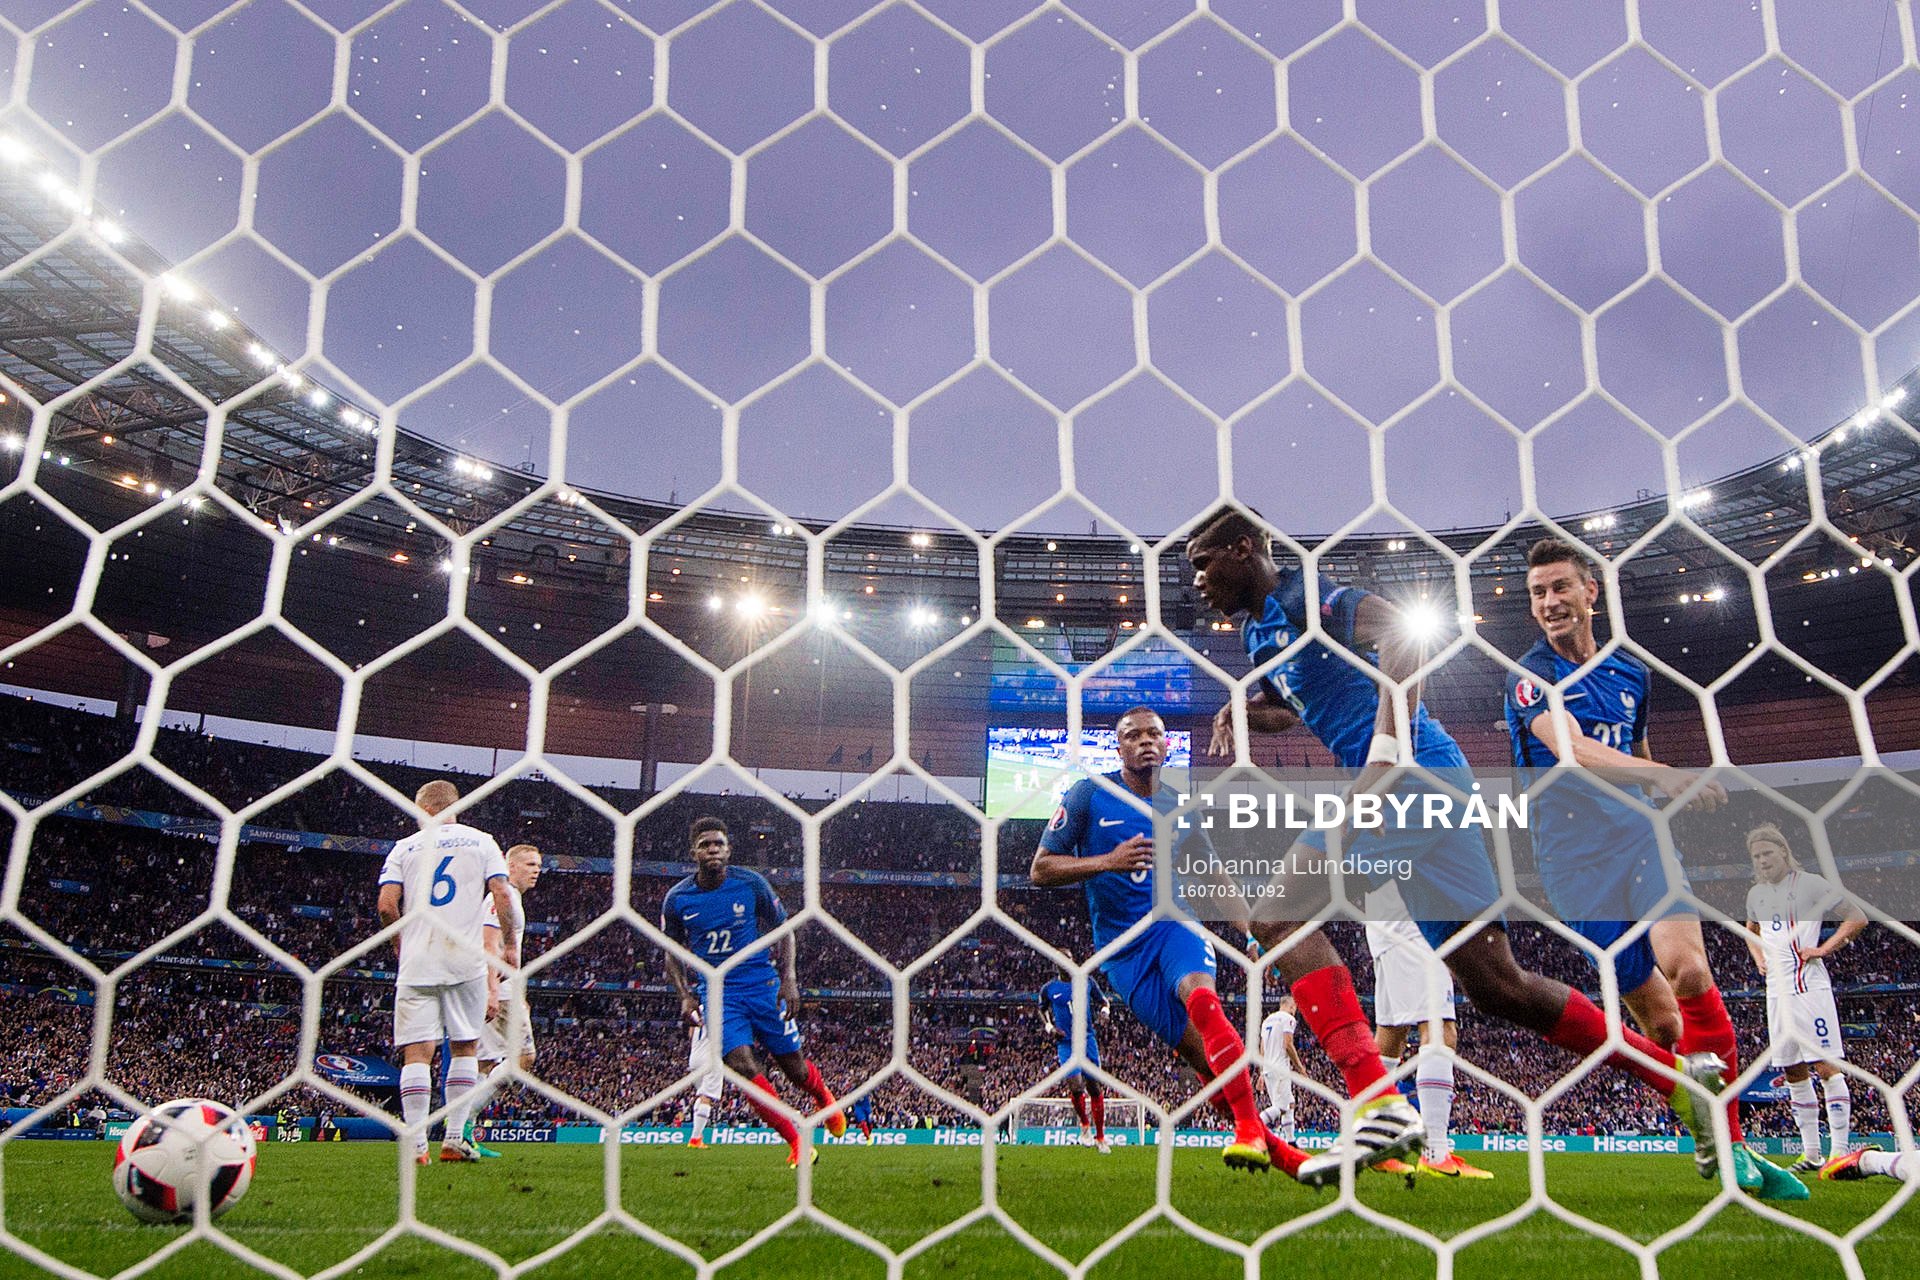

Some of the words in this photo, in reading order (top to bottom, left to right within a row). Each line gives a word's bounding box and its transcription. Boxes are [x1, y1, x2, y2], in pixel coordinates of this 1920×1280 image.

[1593, 722, 1622, 748] 21
[249, 829, 300, 842] SAINT-DENIS
[430, 856, 456, 907] 6
[1772, 913, 1782, 931] 8
[706, 930, 734, 954] 22
[155, 955, 204, 966] SAINT-DENS
[1265, 1026, 1273, 1038] 7
[1814, 1017, 1829, 1037] 8
[490, 1128, 552, 1142] RESPECT
[710, 1128, 785, 1144] Hisens
[1044, 1130, 1126, 1147] Hisse
[1483, 1135, 1567, 1152] Hisese
[1593, 1136, 1677, 1153] Hisense
